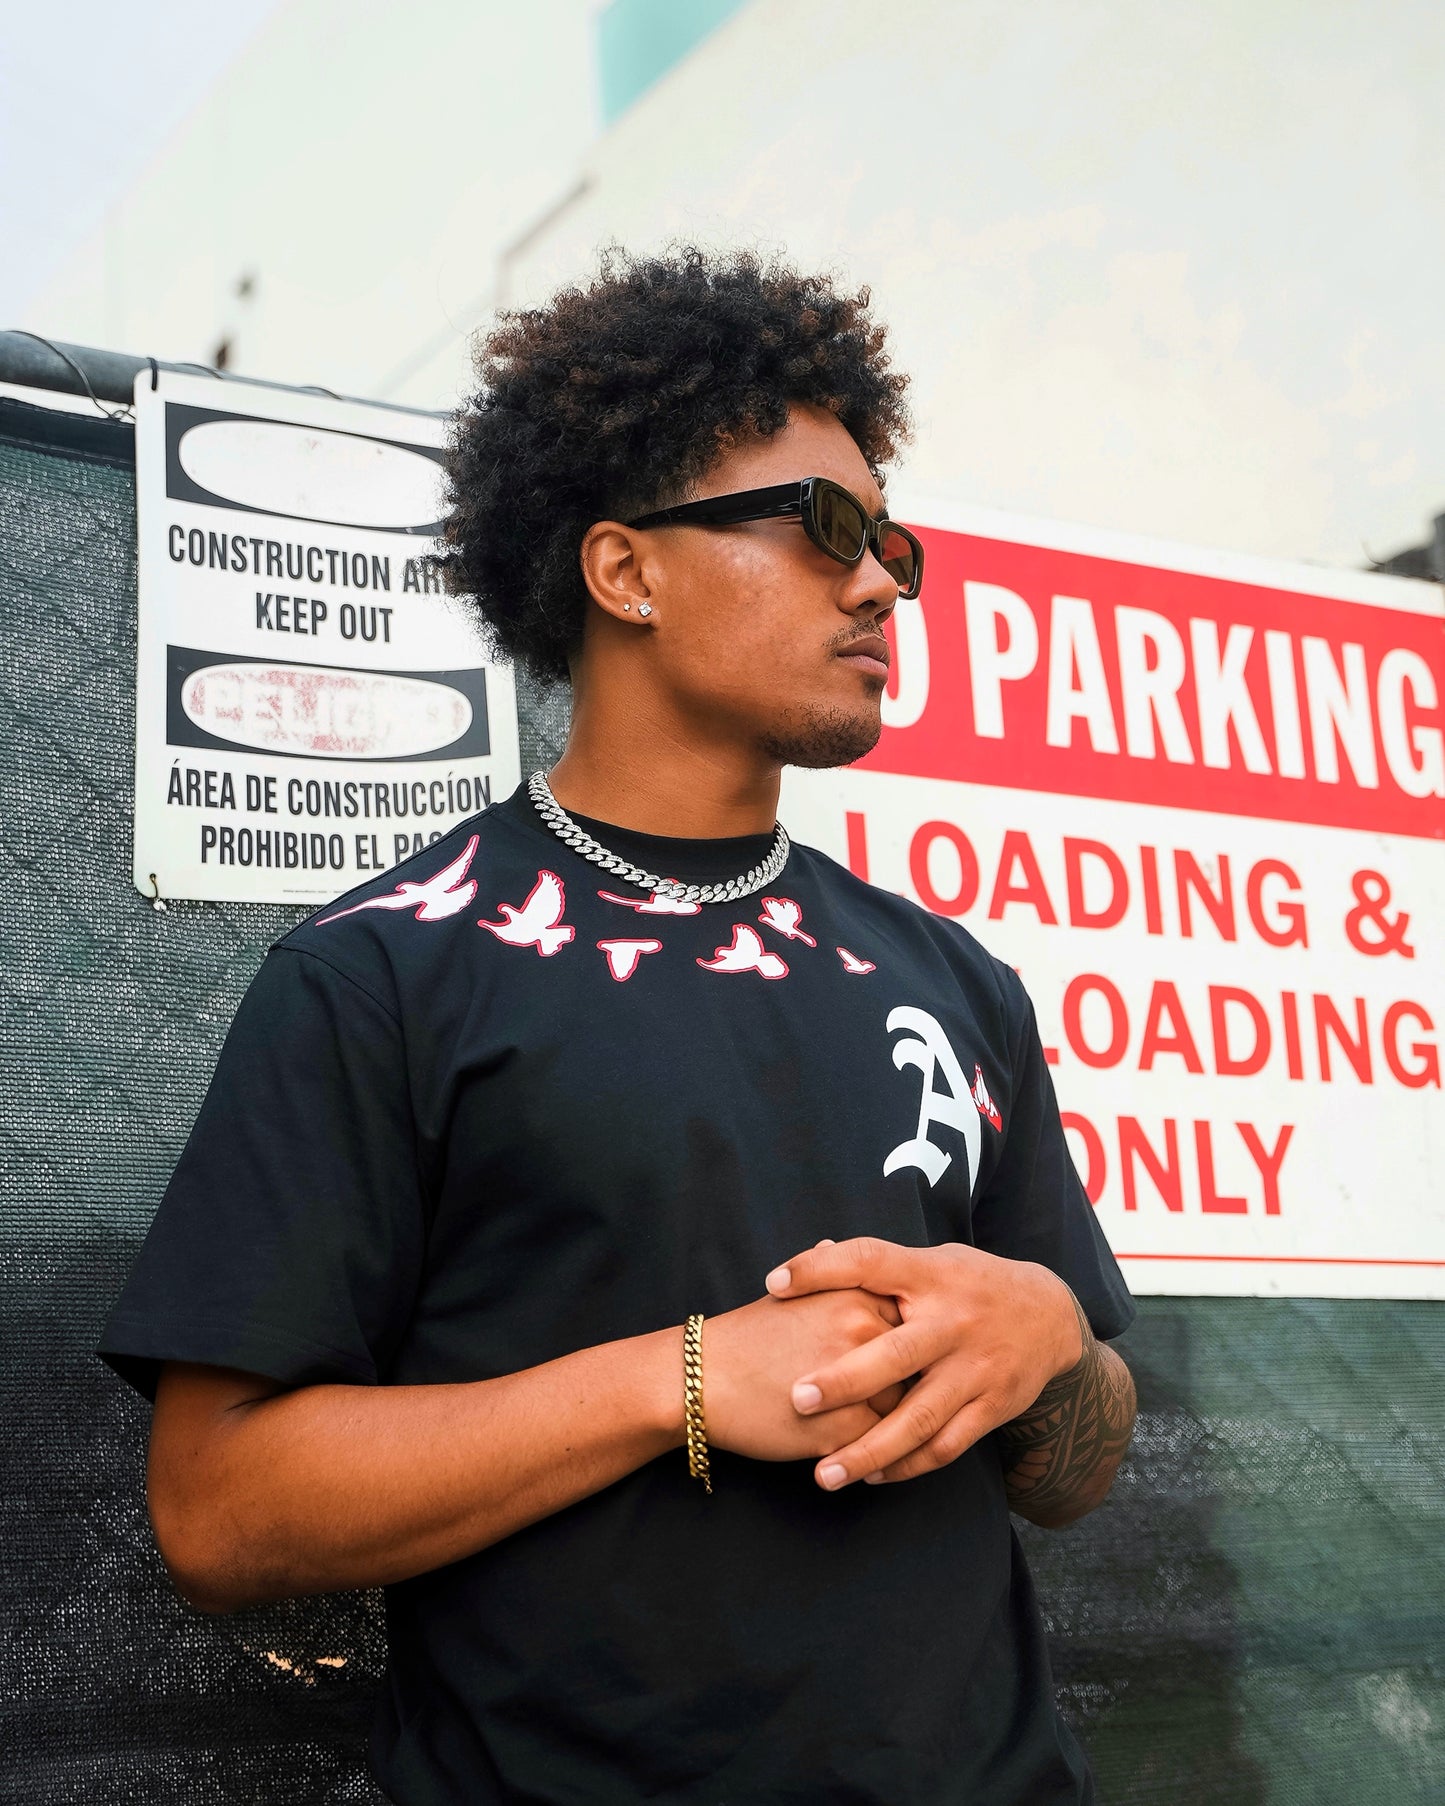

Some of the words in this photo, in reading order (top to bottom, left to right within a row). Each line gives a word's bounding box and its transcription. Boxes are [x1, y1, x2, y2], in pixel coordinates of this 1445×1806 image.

[168, 524, 391, 592] CONSTRUCTION
[402, 558, 449, 596] AR
[256, 592, 328, 636] KEEP
[340, 603, 393, 643] OUT
[963, 580, 1445, 799] PARKING
[167, 758, 237, 810] ÁREA
[246, 774, 278, 814] DE
[201, 824, 345, 870] PROHIBIDO
[355, 834, 385, 870] EL
[1344, 868, 1416, 960] &
[1014, 966, 1442, 1090] OADING
